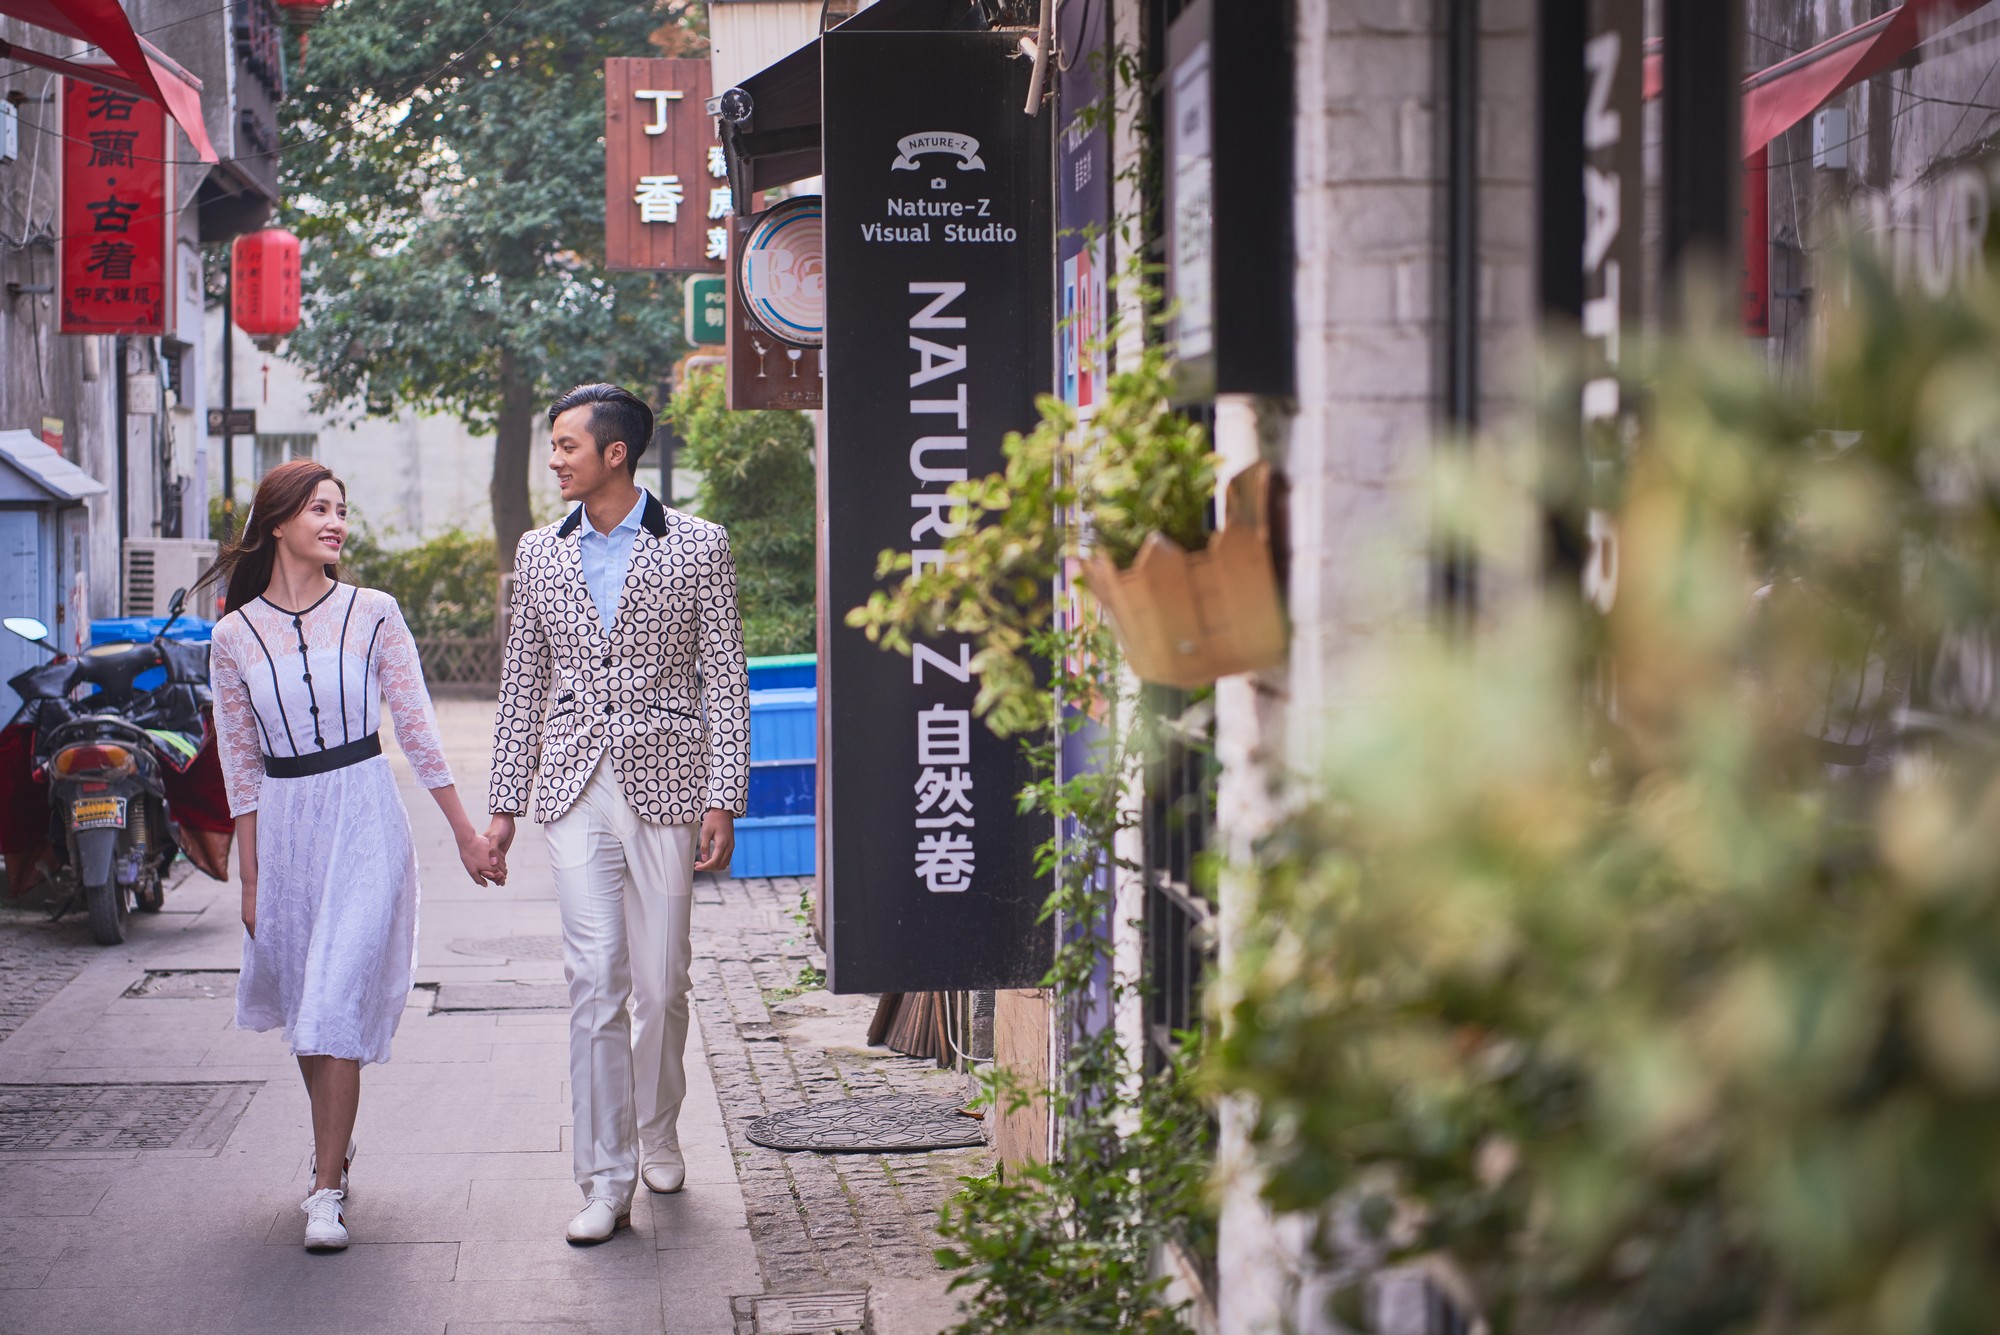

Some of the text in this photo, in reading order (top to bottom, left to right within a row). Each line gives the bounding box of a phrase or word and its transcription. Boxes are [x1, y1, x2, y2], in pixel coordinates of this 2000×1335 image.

[908, 137, 969, 150] NATURE-Z
[633, 90, 684, 223] 丁香
[887, 198, 991, 217] Nature-Z
[860, 222, 1017, 242] Visual Studio
[914, 703, 976, 893] 自然卷
